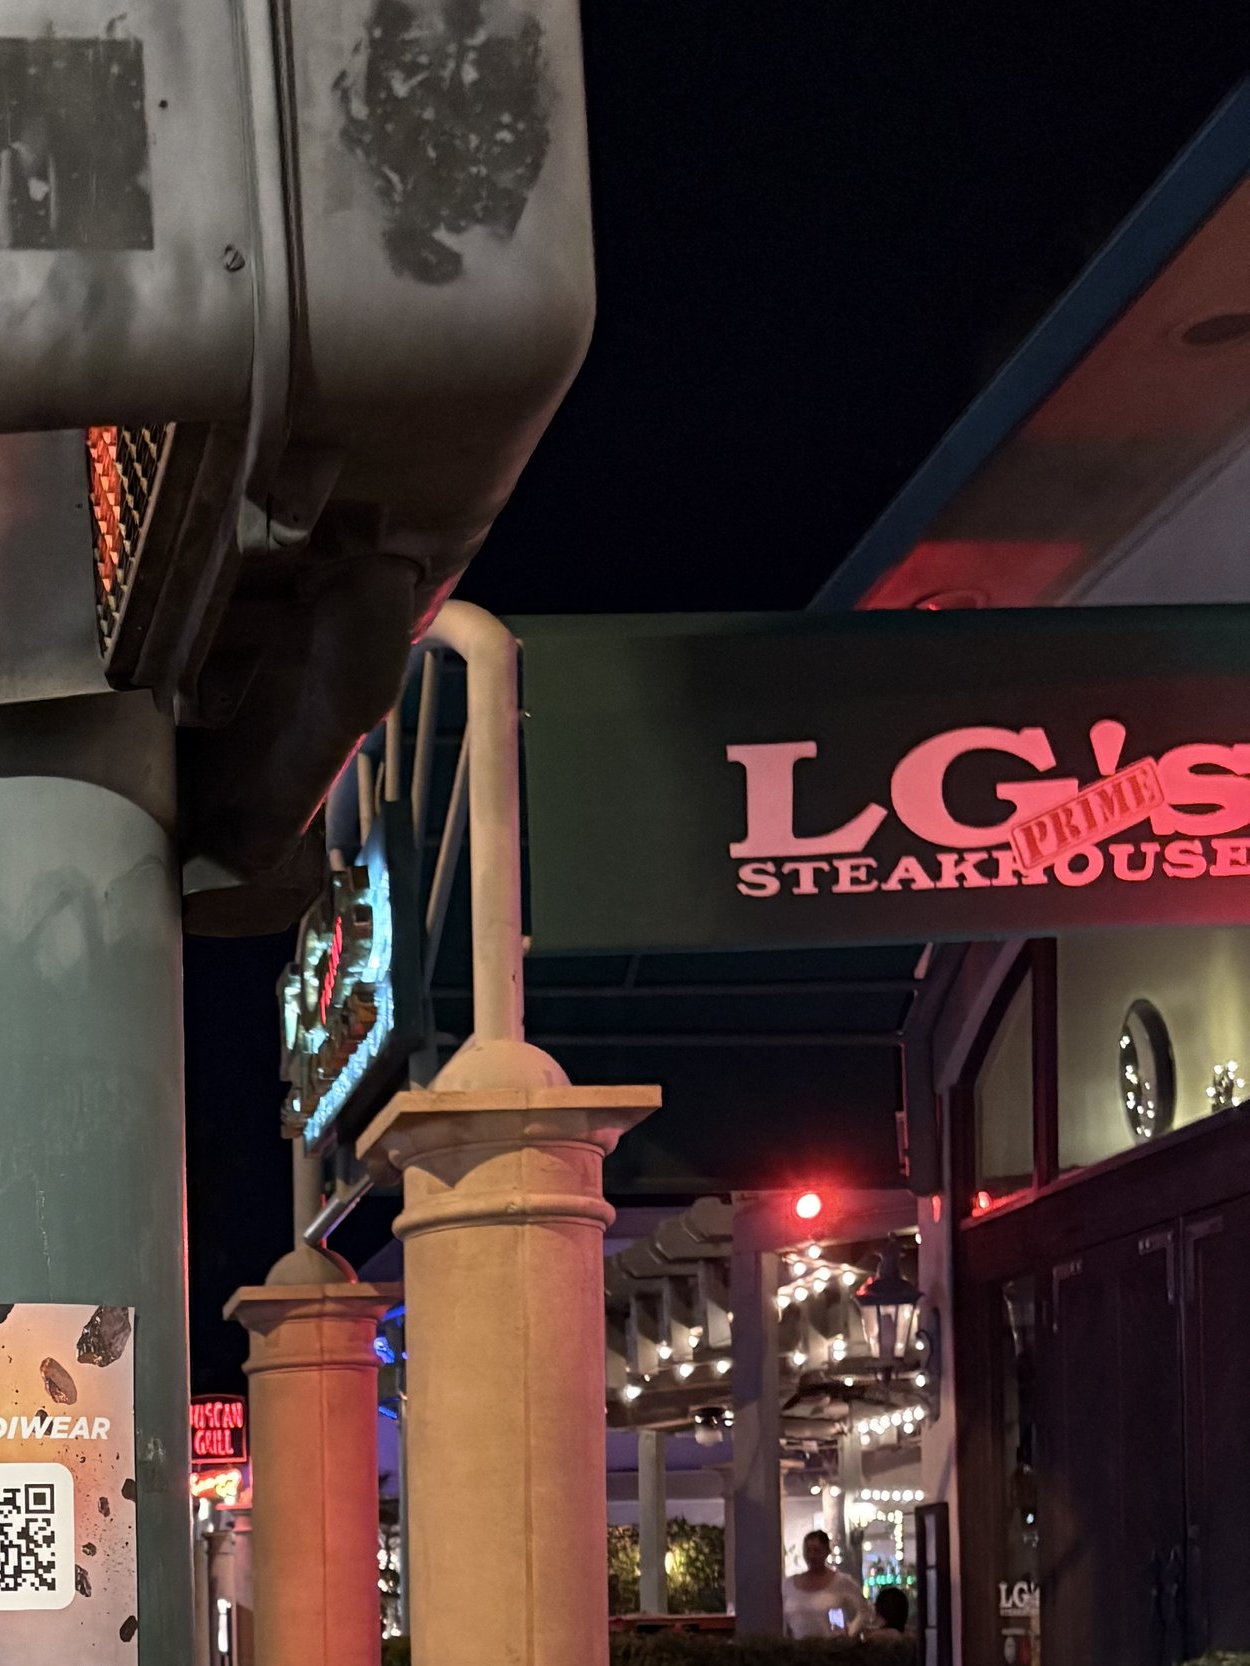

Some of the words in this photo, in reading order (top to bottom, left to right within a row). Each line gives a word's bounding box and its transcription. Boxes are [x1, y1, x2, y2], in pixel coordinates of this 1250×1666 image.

[1021, 767, 1156, 864] PRIME
[737, 838, 1250, 897] STEAKHOUSE
[190, 1401, 244, 1429] USCAN
[193, 1428, 235, 1456] GRILL
